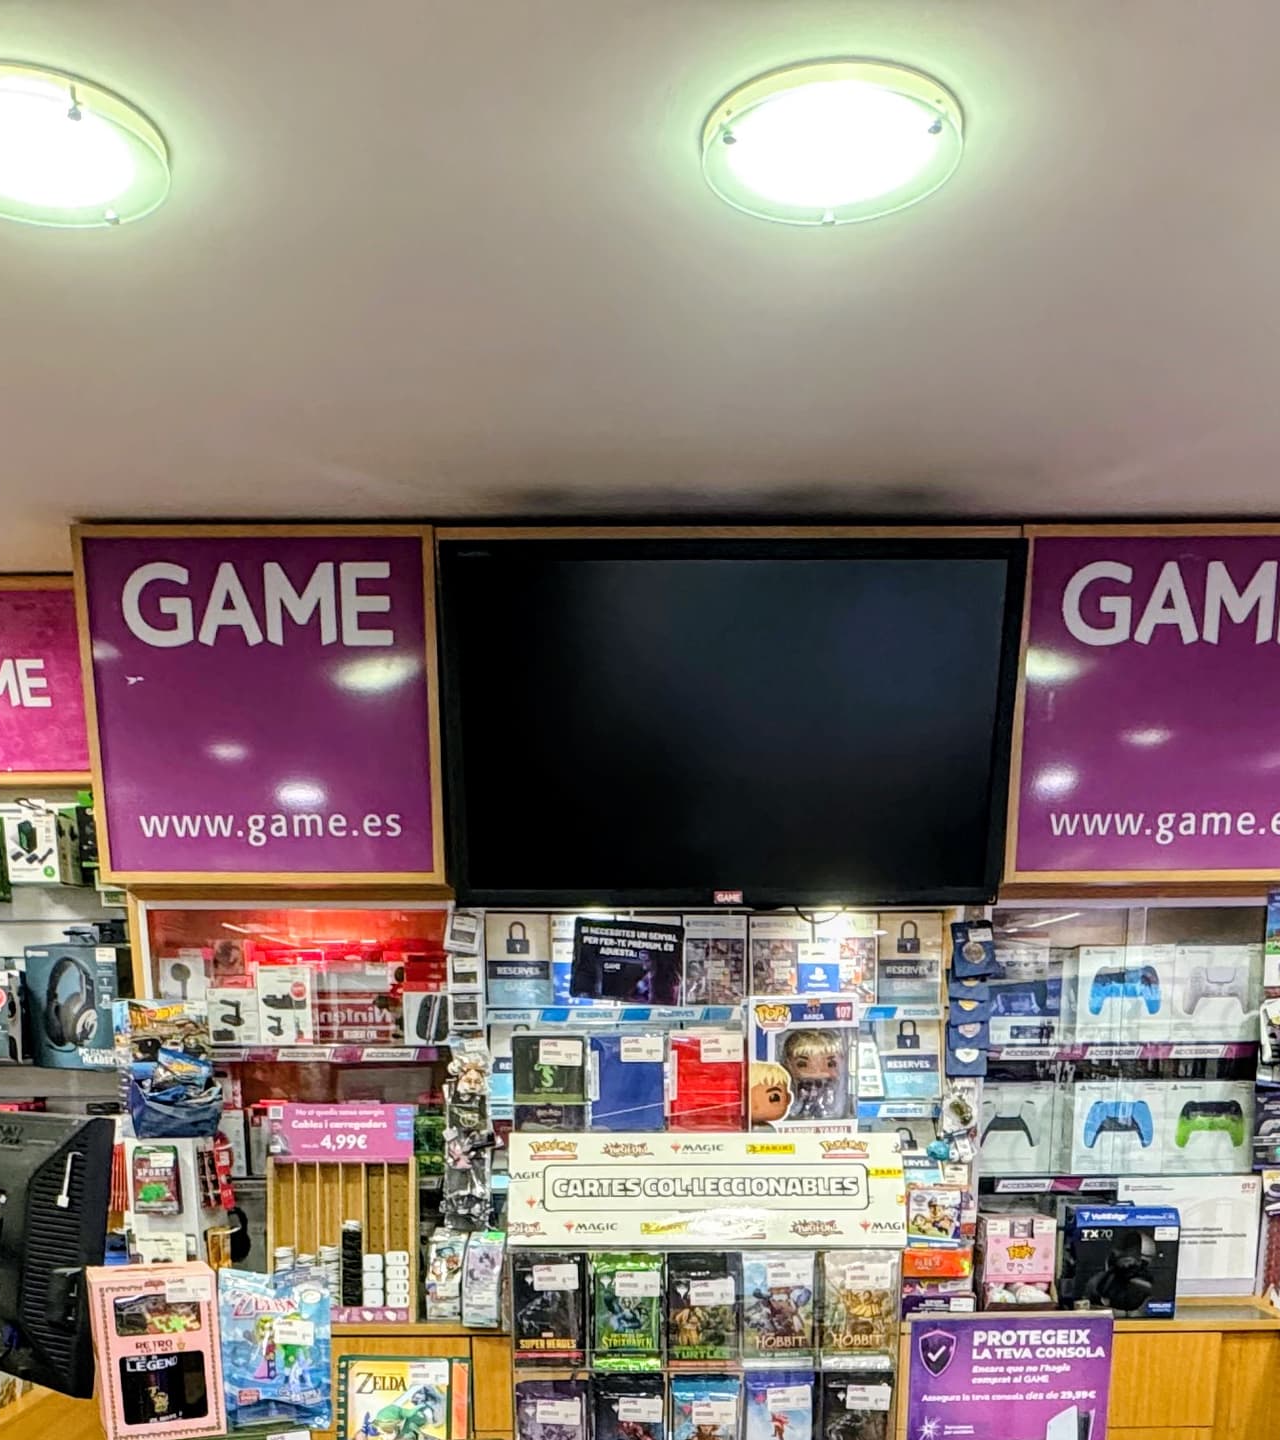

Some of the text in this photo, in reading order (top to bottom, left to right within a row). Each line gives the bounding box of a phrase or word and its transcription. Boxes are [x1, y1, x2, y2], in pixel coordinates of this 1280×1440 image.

[121, 560, 393, 648] GAME
[139, 809, 403, 846] www.game.es
[716, 893, 741, 902] GAME
[756, 1005, 789, 1023] POP!
[836, 1006, 851, 1019] 107
[887, 1060, 930, 1069] RESERVES
[321, 1134, 368, 1151] 4,99€
[136, 1168, 174, 1178] SPORTS
[552, 1178, 641, 1198] CARTES
[755, 1335, 806, 1349] HOBBIT
[832, 1334, 883, 1347] HOBBIT
[973, 1330, 1090, 1346] PROTEGEIX
[972, 1346, 1105, 1360] LA TEVA CONSOLA
[126, 1357, 178, 1372] LEGEND
[355, 1371, 408, 1394] ZELDA
